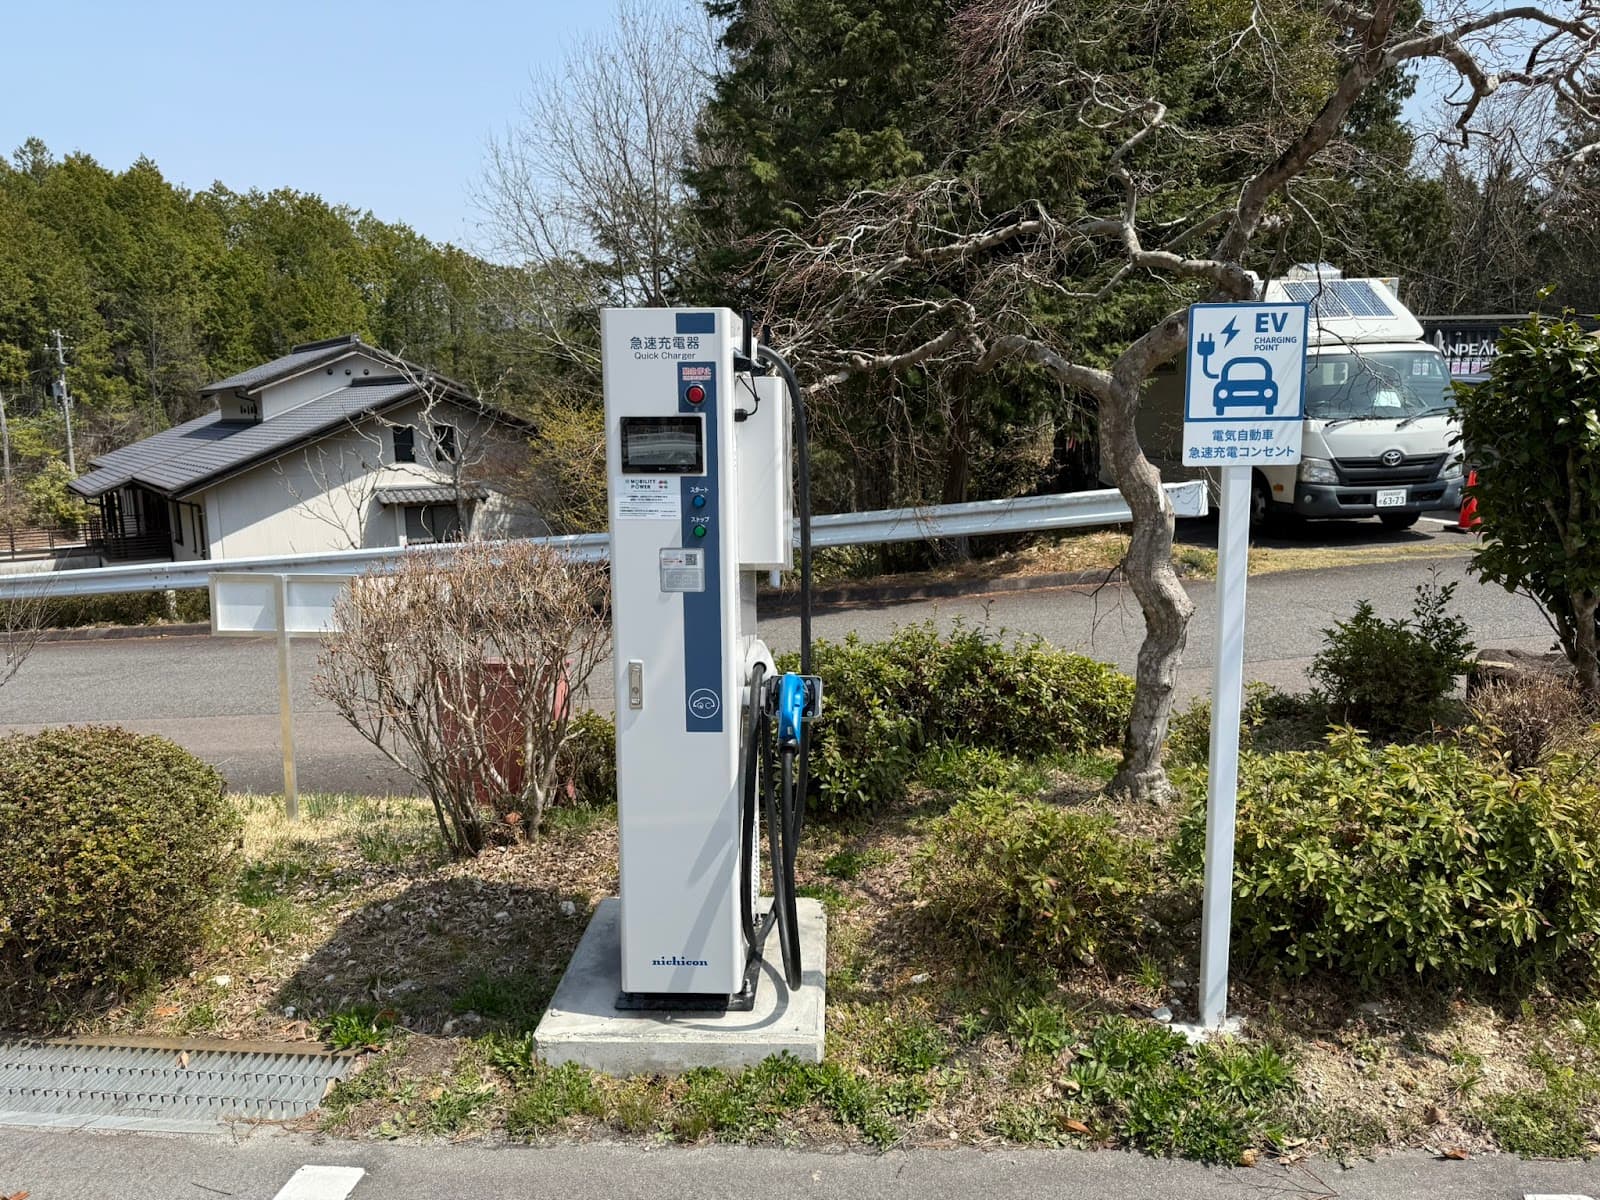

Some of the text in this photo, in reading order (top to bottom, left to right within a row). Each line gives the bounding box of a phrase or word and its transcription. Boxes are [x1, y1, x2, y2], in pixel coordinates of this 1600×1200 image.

[1255, 312, 1289, 333] EV
[630, 336, 700, 350] 急速充電器
[1254, 336, 1297, 344] CHARGING
[634, 351, 696, 361] Quick Charger
[1212, 429, 1274, 442] 電気自動車
[1188, 446, 1295, 459] 急速充電コンセント
[652, 956, 708, 966] nichicon
